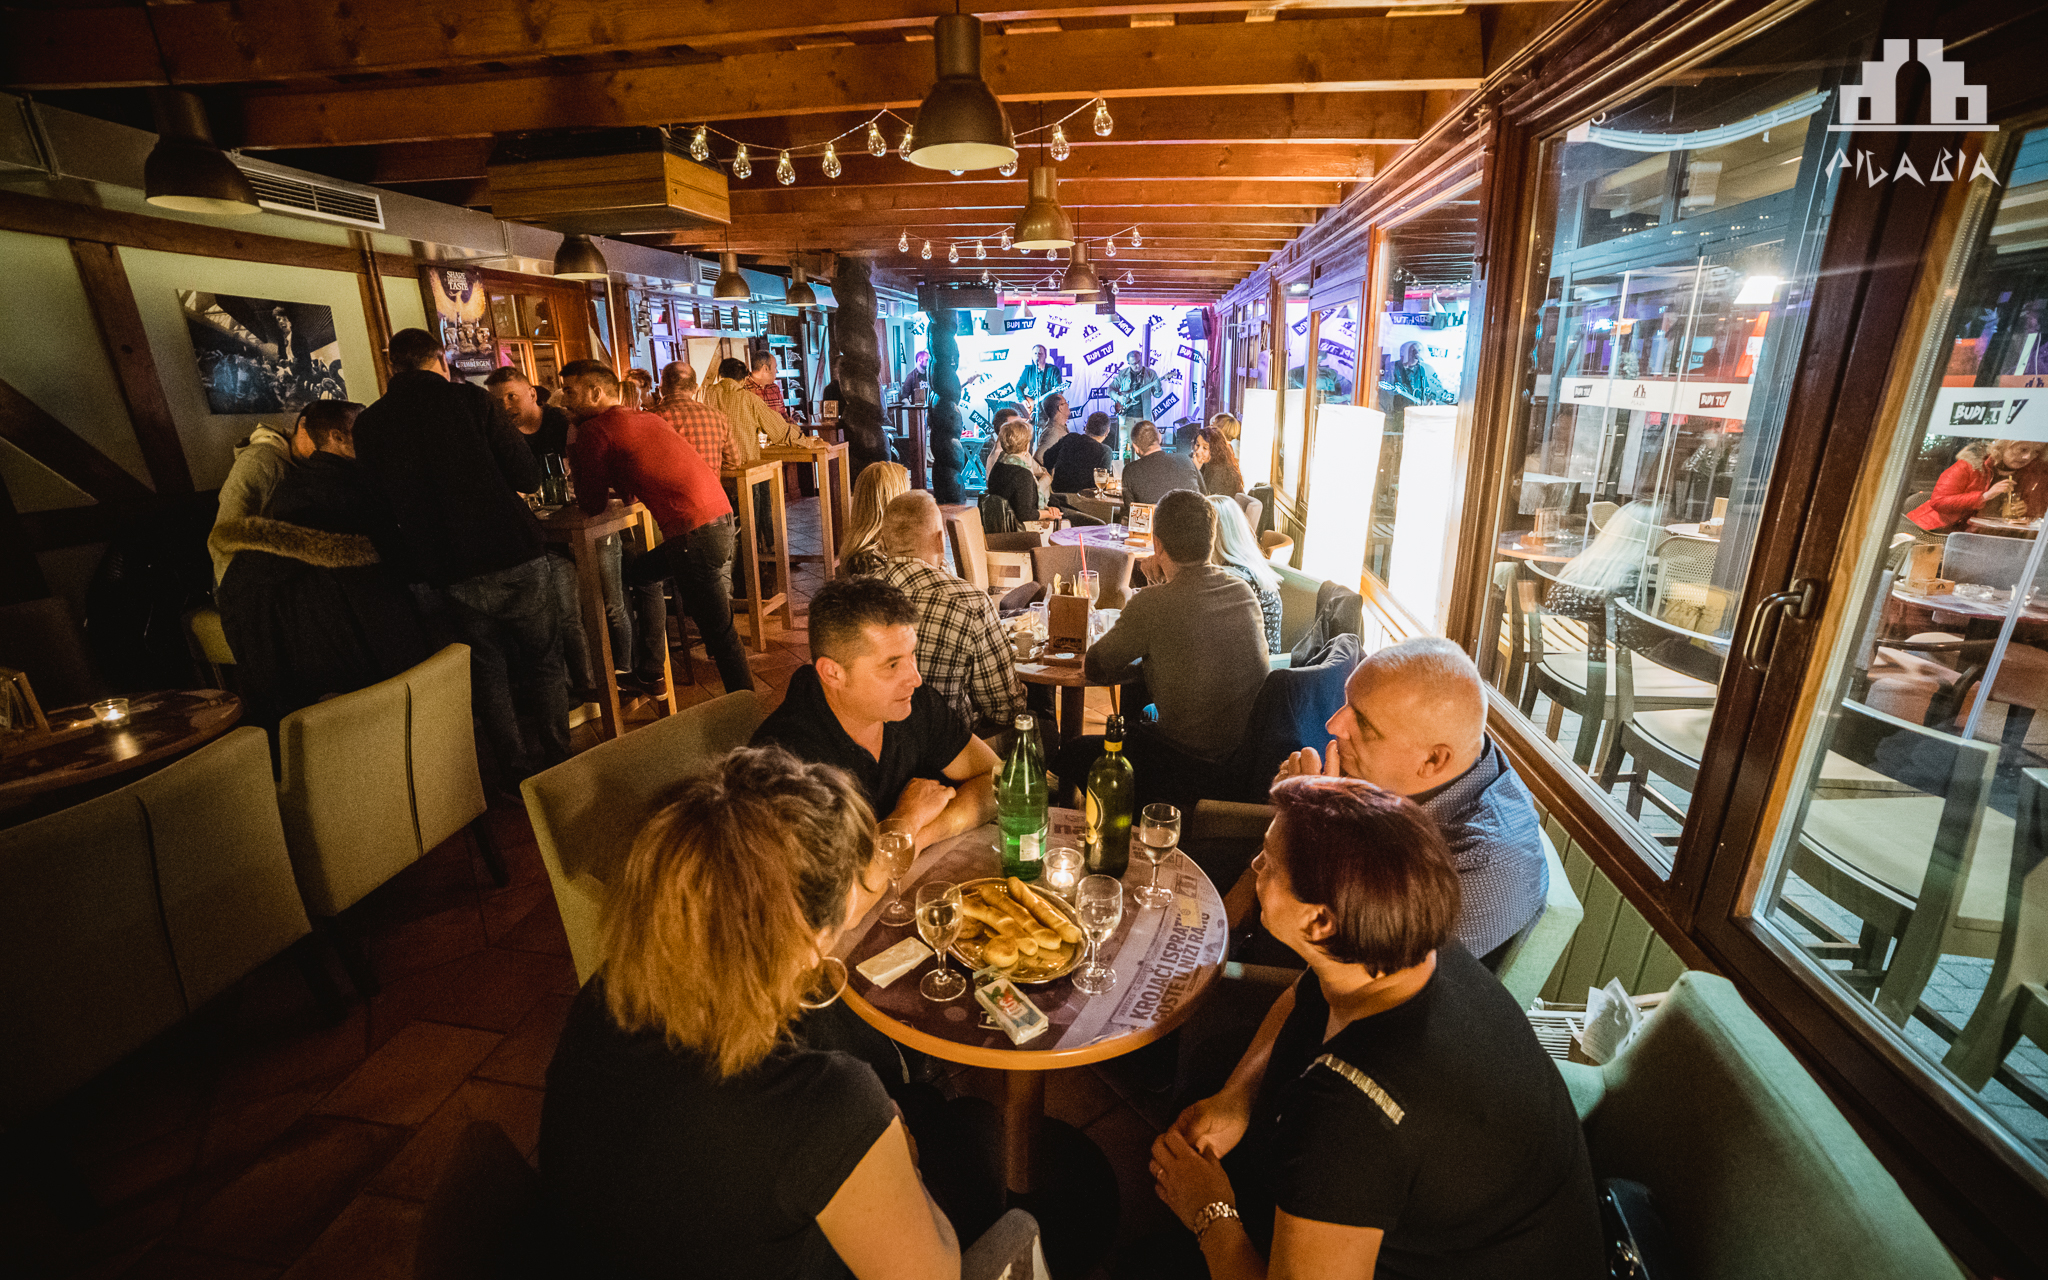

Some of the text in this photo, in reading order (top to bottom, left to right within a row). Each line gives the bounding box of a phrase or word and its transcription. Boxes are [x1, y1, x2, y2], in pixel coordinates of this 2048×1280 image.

[447, 282, 469, 290] TASTE
[1715, 395, 1727, 406] TU!
[1129, 963, 1175, 1020] KROJAČI
